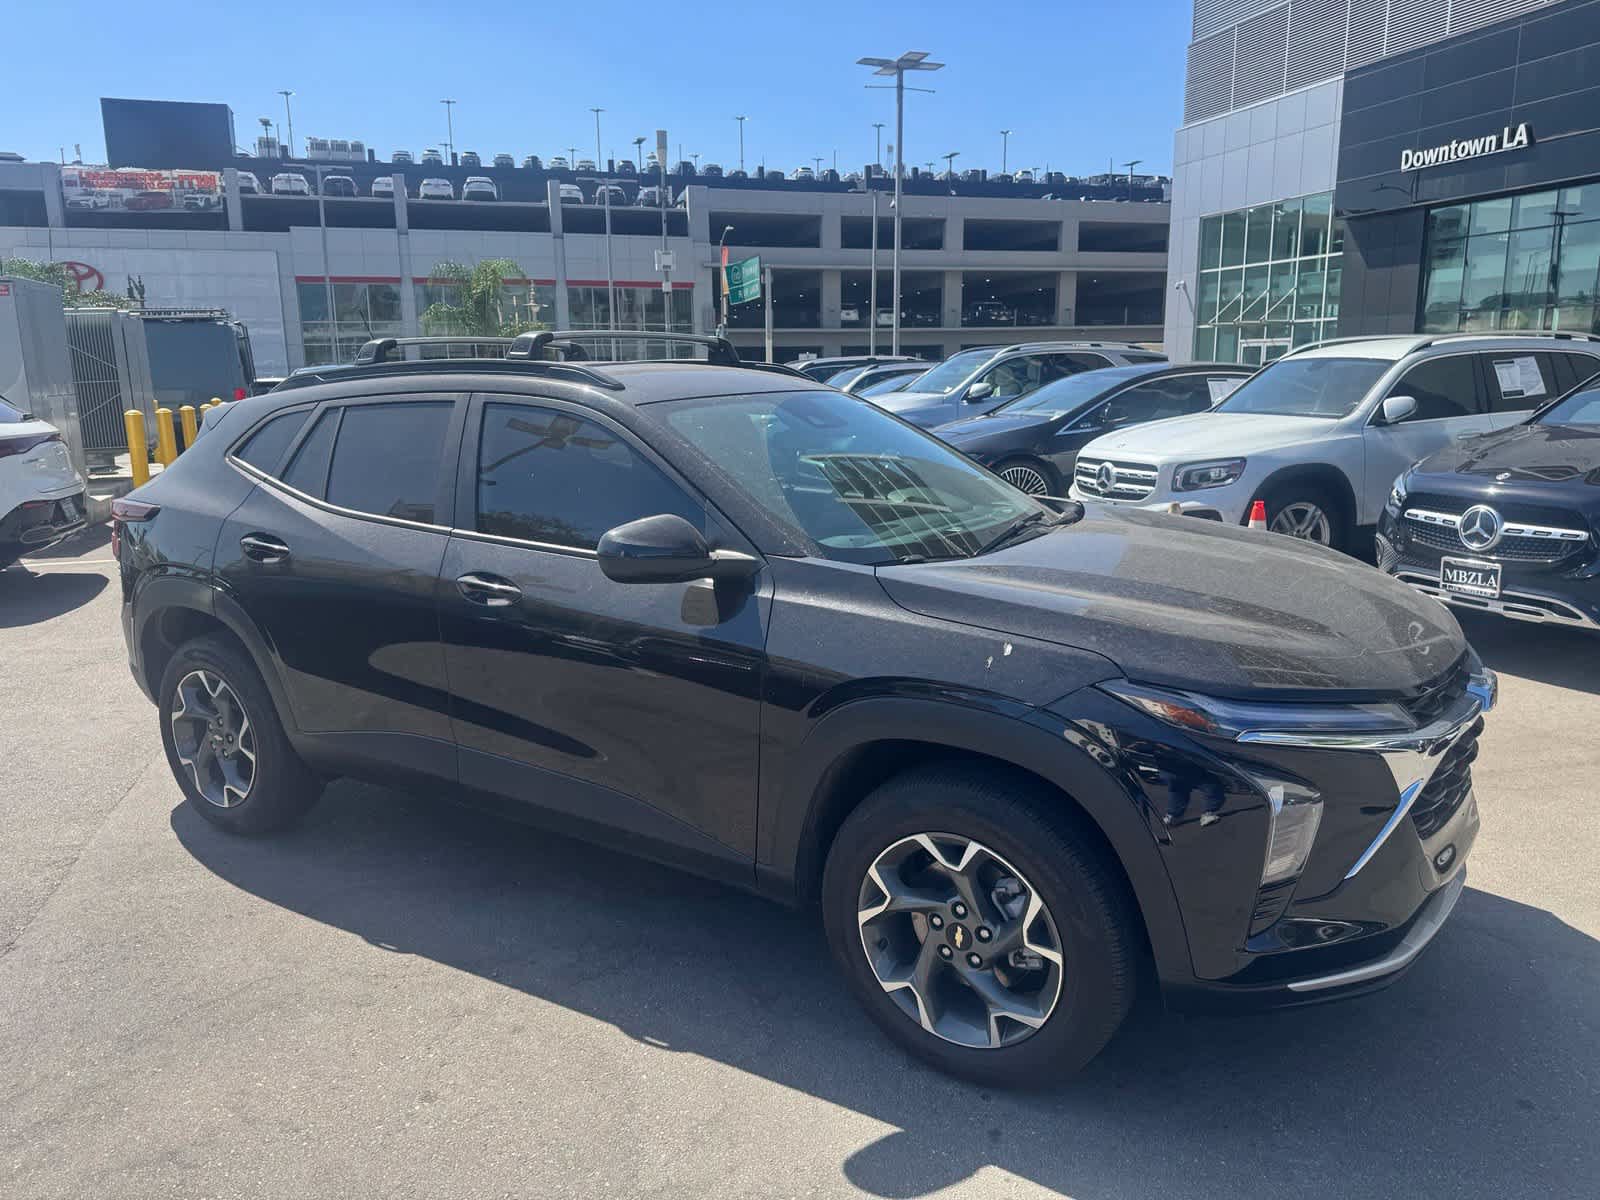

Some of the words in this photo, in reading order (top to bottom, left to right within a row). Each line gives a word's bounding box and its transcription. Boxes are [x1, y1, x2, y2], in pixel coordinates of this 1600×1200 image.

[1401, 134, 1497, 171] Downtown
[1502, 123, 1529, 150] LA
[1444, 568, 1497, 587] MBZLA
